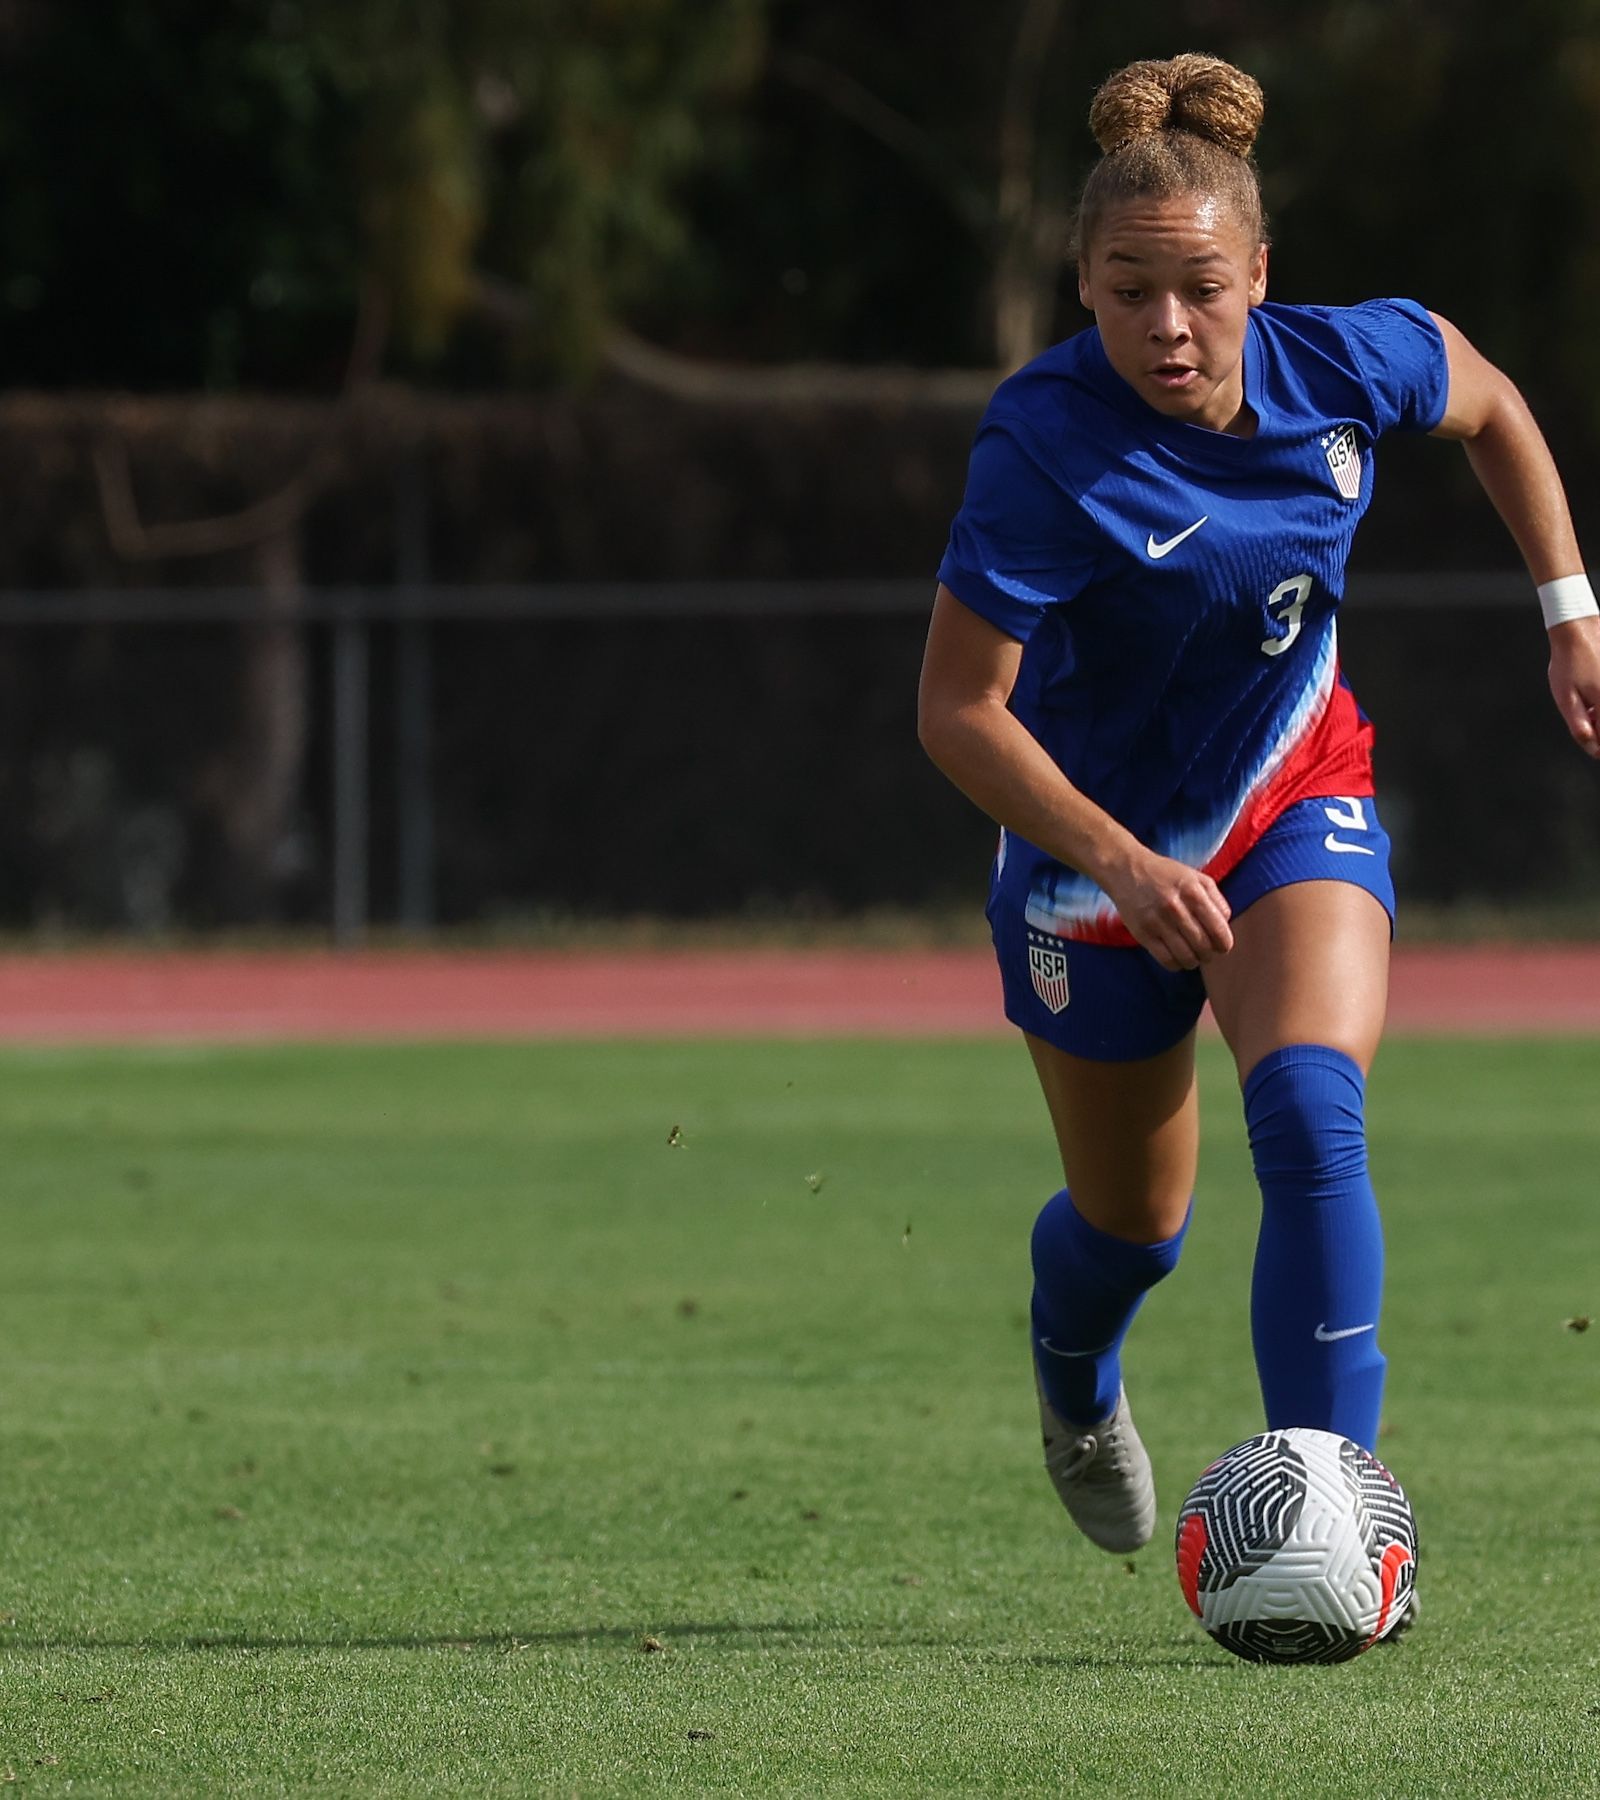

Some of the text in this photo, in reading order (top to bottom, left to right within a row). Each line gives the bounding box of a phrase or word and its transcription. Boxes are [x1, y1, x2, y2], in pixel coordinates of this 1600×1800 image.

[1329, 430, 1355, 468] USA
[1260, 573, 1314, 657] 3
[1031, 949, 1065, 979] USA
